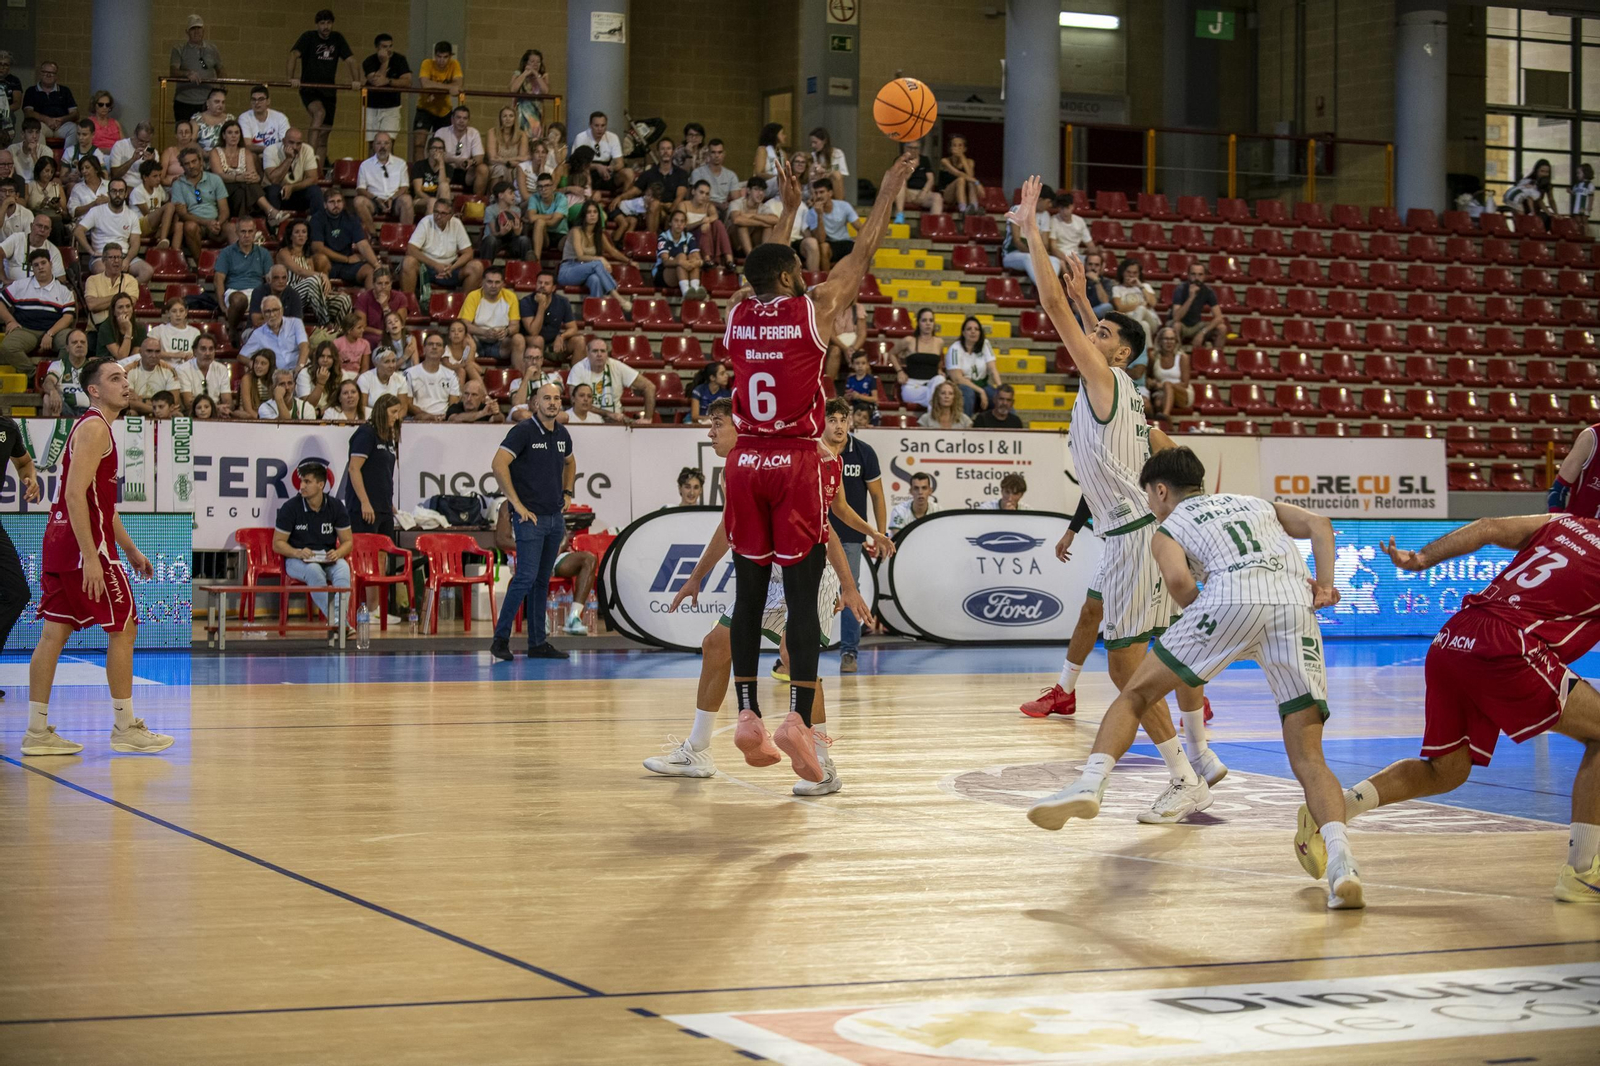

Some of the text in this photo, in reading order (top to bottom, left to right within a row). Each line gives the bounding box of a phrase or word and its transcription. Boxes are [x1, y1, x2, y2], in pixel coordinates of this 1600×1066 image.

[1209, 11, 1222, 35] J
[732, 325, 802, 340] FAIAL PEREIRA
[171, 337, 190, 352] CCB
[745, 349, 784, 360] Blanca
[748, 372, 777, 421] 6
[900, 437, 931, 453] San
[935, 438, 985, 455] Carlos
[997, 440, 1009, 455] &
[762, 454, 791, 468] ACM
[844, 463, 861, 477] CCB
[983, 482, 1000, 496] de
[1364, 498, 1370, 512] y
[1374, 495, 1436, 510] Reformas
[1222, 520, 1262, 557] 11
[976, 556, 1042, 575] TYSA
[1504, 545, 1569, 589] 13
[650, 600, 727, 613] Coeduría
[983, 592, 1043, 619] Ford
[1394, 587, 1475, 615] de C
[1449, 635, 1476, 650] ACM
